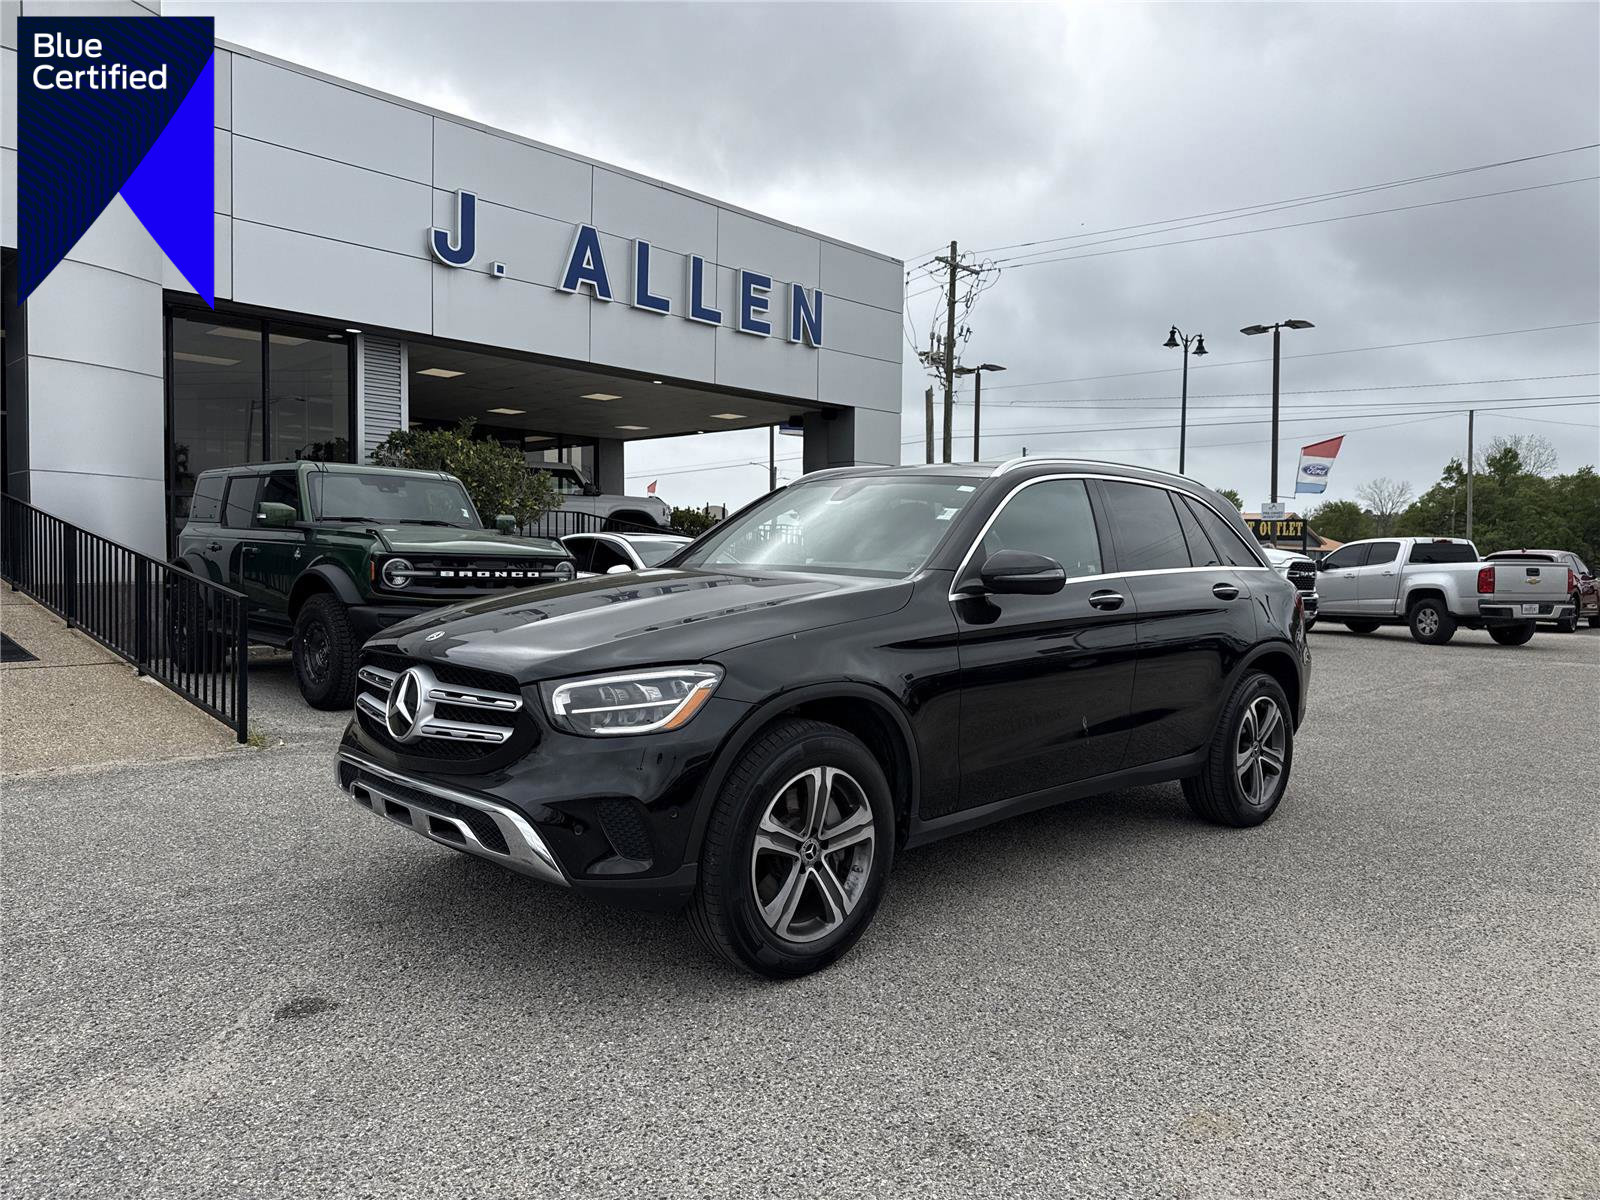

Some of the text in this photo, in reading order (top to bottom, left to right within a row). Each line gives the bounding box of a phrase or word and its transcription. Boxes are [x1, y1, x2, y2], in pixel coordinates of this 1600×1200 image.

[428, 188, 824, 349] J. ALLEN
[1306, 465, 1327, 475] Ford
[440, 570, 540, 578] BRONCO
